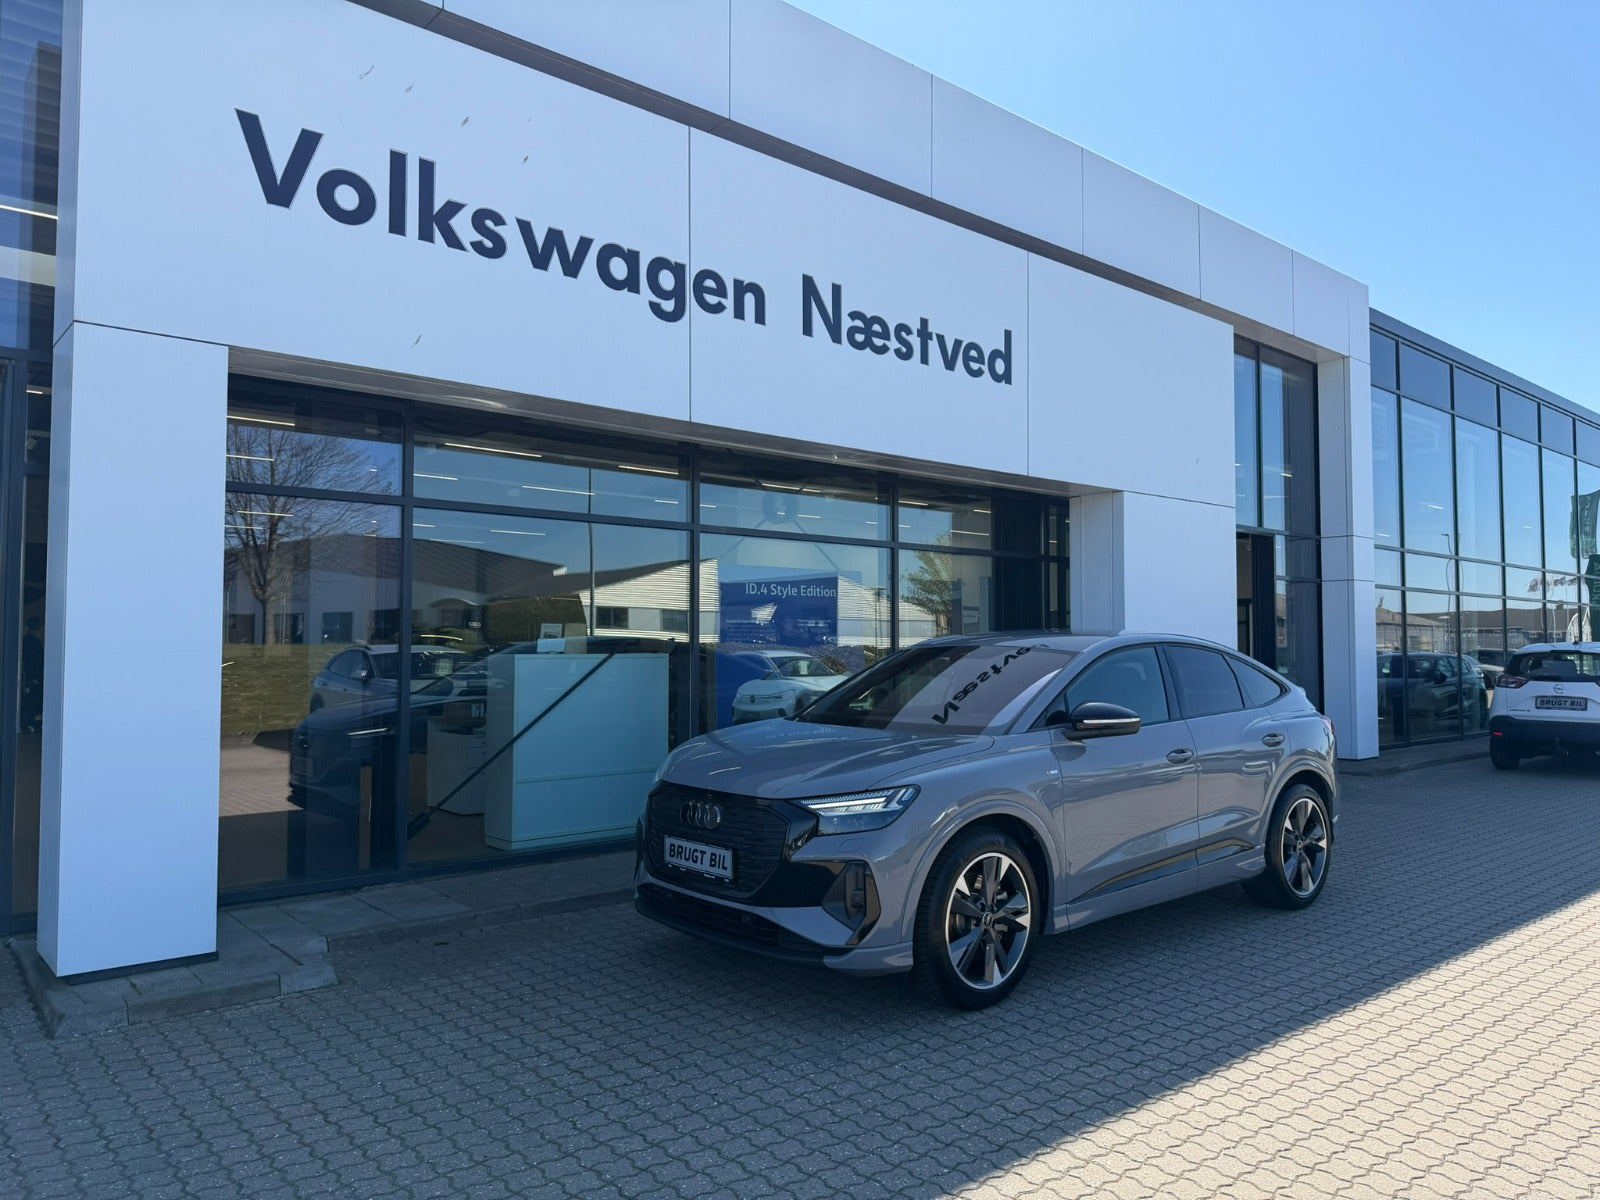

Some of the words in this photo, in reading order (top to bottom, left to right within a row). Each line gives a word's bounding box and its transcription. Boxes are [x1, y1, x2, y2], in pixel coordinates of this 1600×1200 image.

[234, 107, 766, 323] Volkswagen
[801, 273, 1013, 386] Næstved
[745, 582, 768, 596] ID.4
[770, 583, 798, 598] Style
[800, 585, 837, 598] Edition
[1540, 699, 1567, 707] BRUGT
[669, 843, 707, 866] BRUGT
[709, 852, 729, 871] BIL
